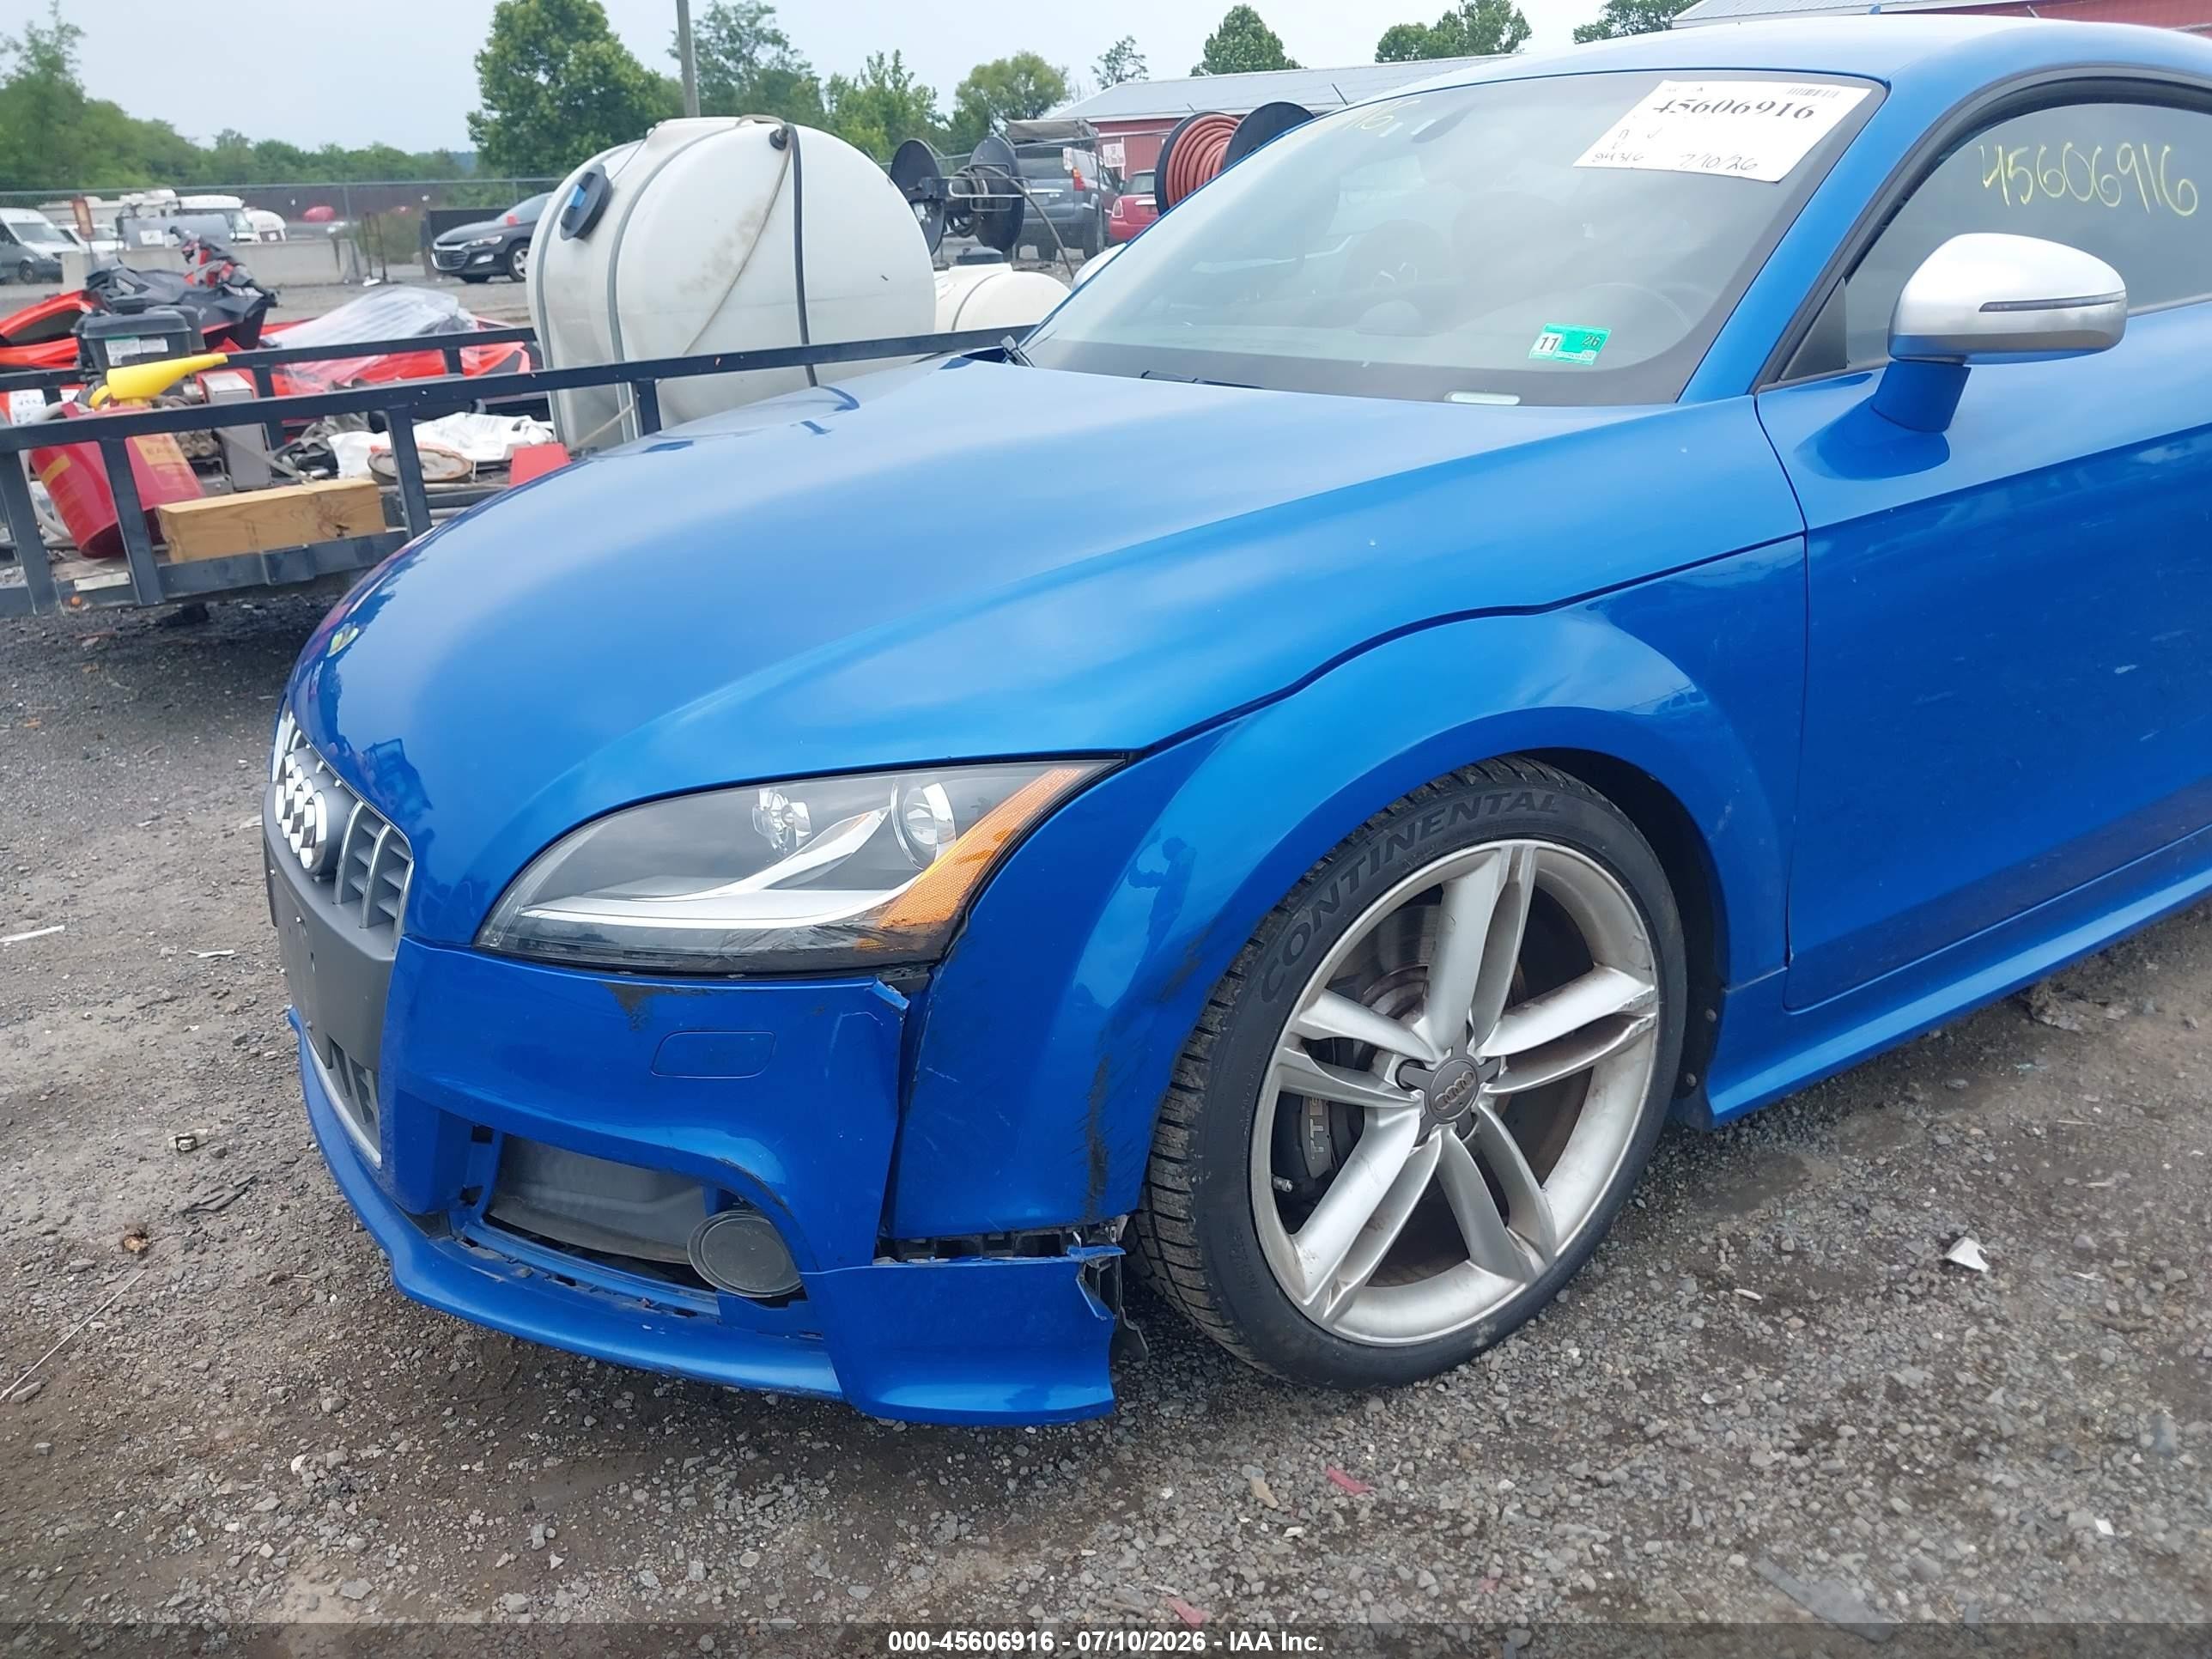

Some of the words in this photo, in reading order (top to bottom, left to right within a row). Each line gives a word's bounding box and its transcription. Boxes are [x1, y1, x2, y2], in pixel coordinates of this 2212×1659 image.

[1652, 98, 1815, 119] 45606916
[1978, 142, 2198, 216] 45606916
[1540, 336, 1559, 350] 11
[1582, 334, 1602, 348] 26
[1260, 792, 1560, 1004] CONTINENTAL
